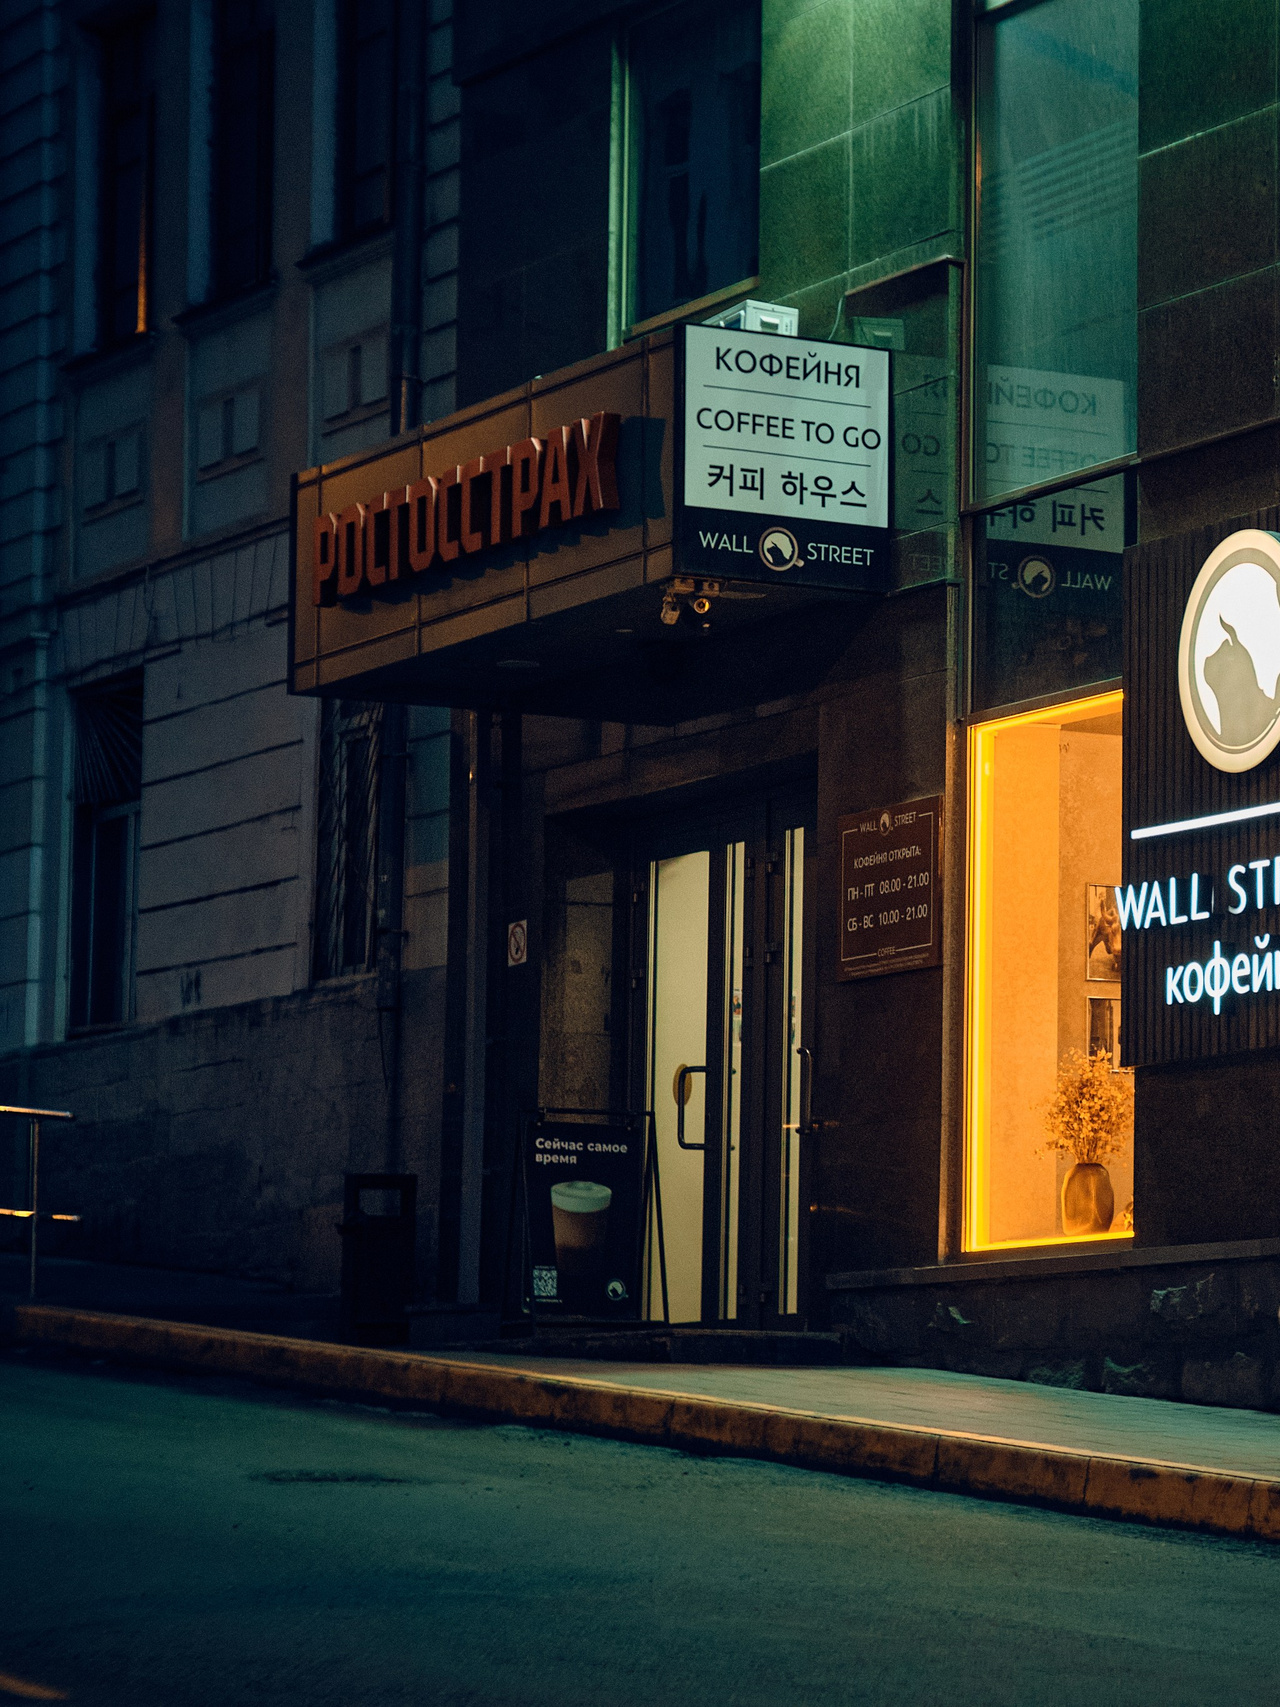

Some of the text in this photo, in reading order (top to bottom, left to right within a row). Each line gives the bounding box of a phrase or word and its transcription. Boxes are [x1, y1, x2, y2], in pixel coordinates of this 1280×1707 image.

[716, 347, 860, 388] КОФЕЙНЯ
[696, 408, 881, 449] COFFEE TO GO
[708, 464, 867, 507] 커피 하우스
[313, 410, 622, 607] РОСГОССТРАХ
[699, 530, 874, 566] WALL STREET
[859, 811, 916, 833] WALL STREET
[853, 852, 888, 869] КОФЕЙНЯ
[1114, 872, 1210, 931] WALL
[535, 1137, 628, 1154] Сейчас самое
[535, 1152, 578, 1165] время
